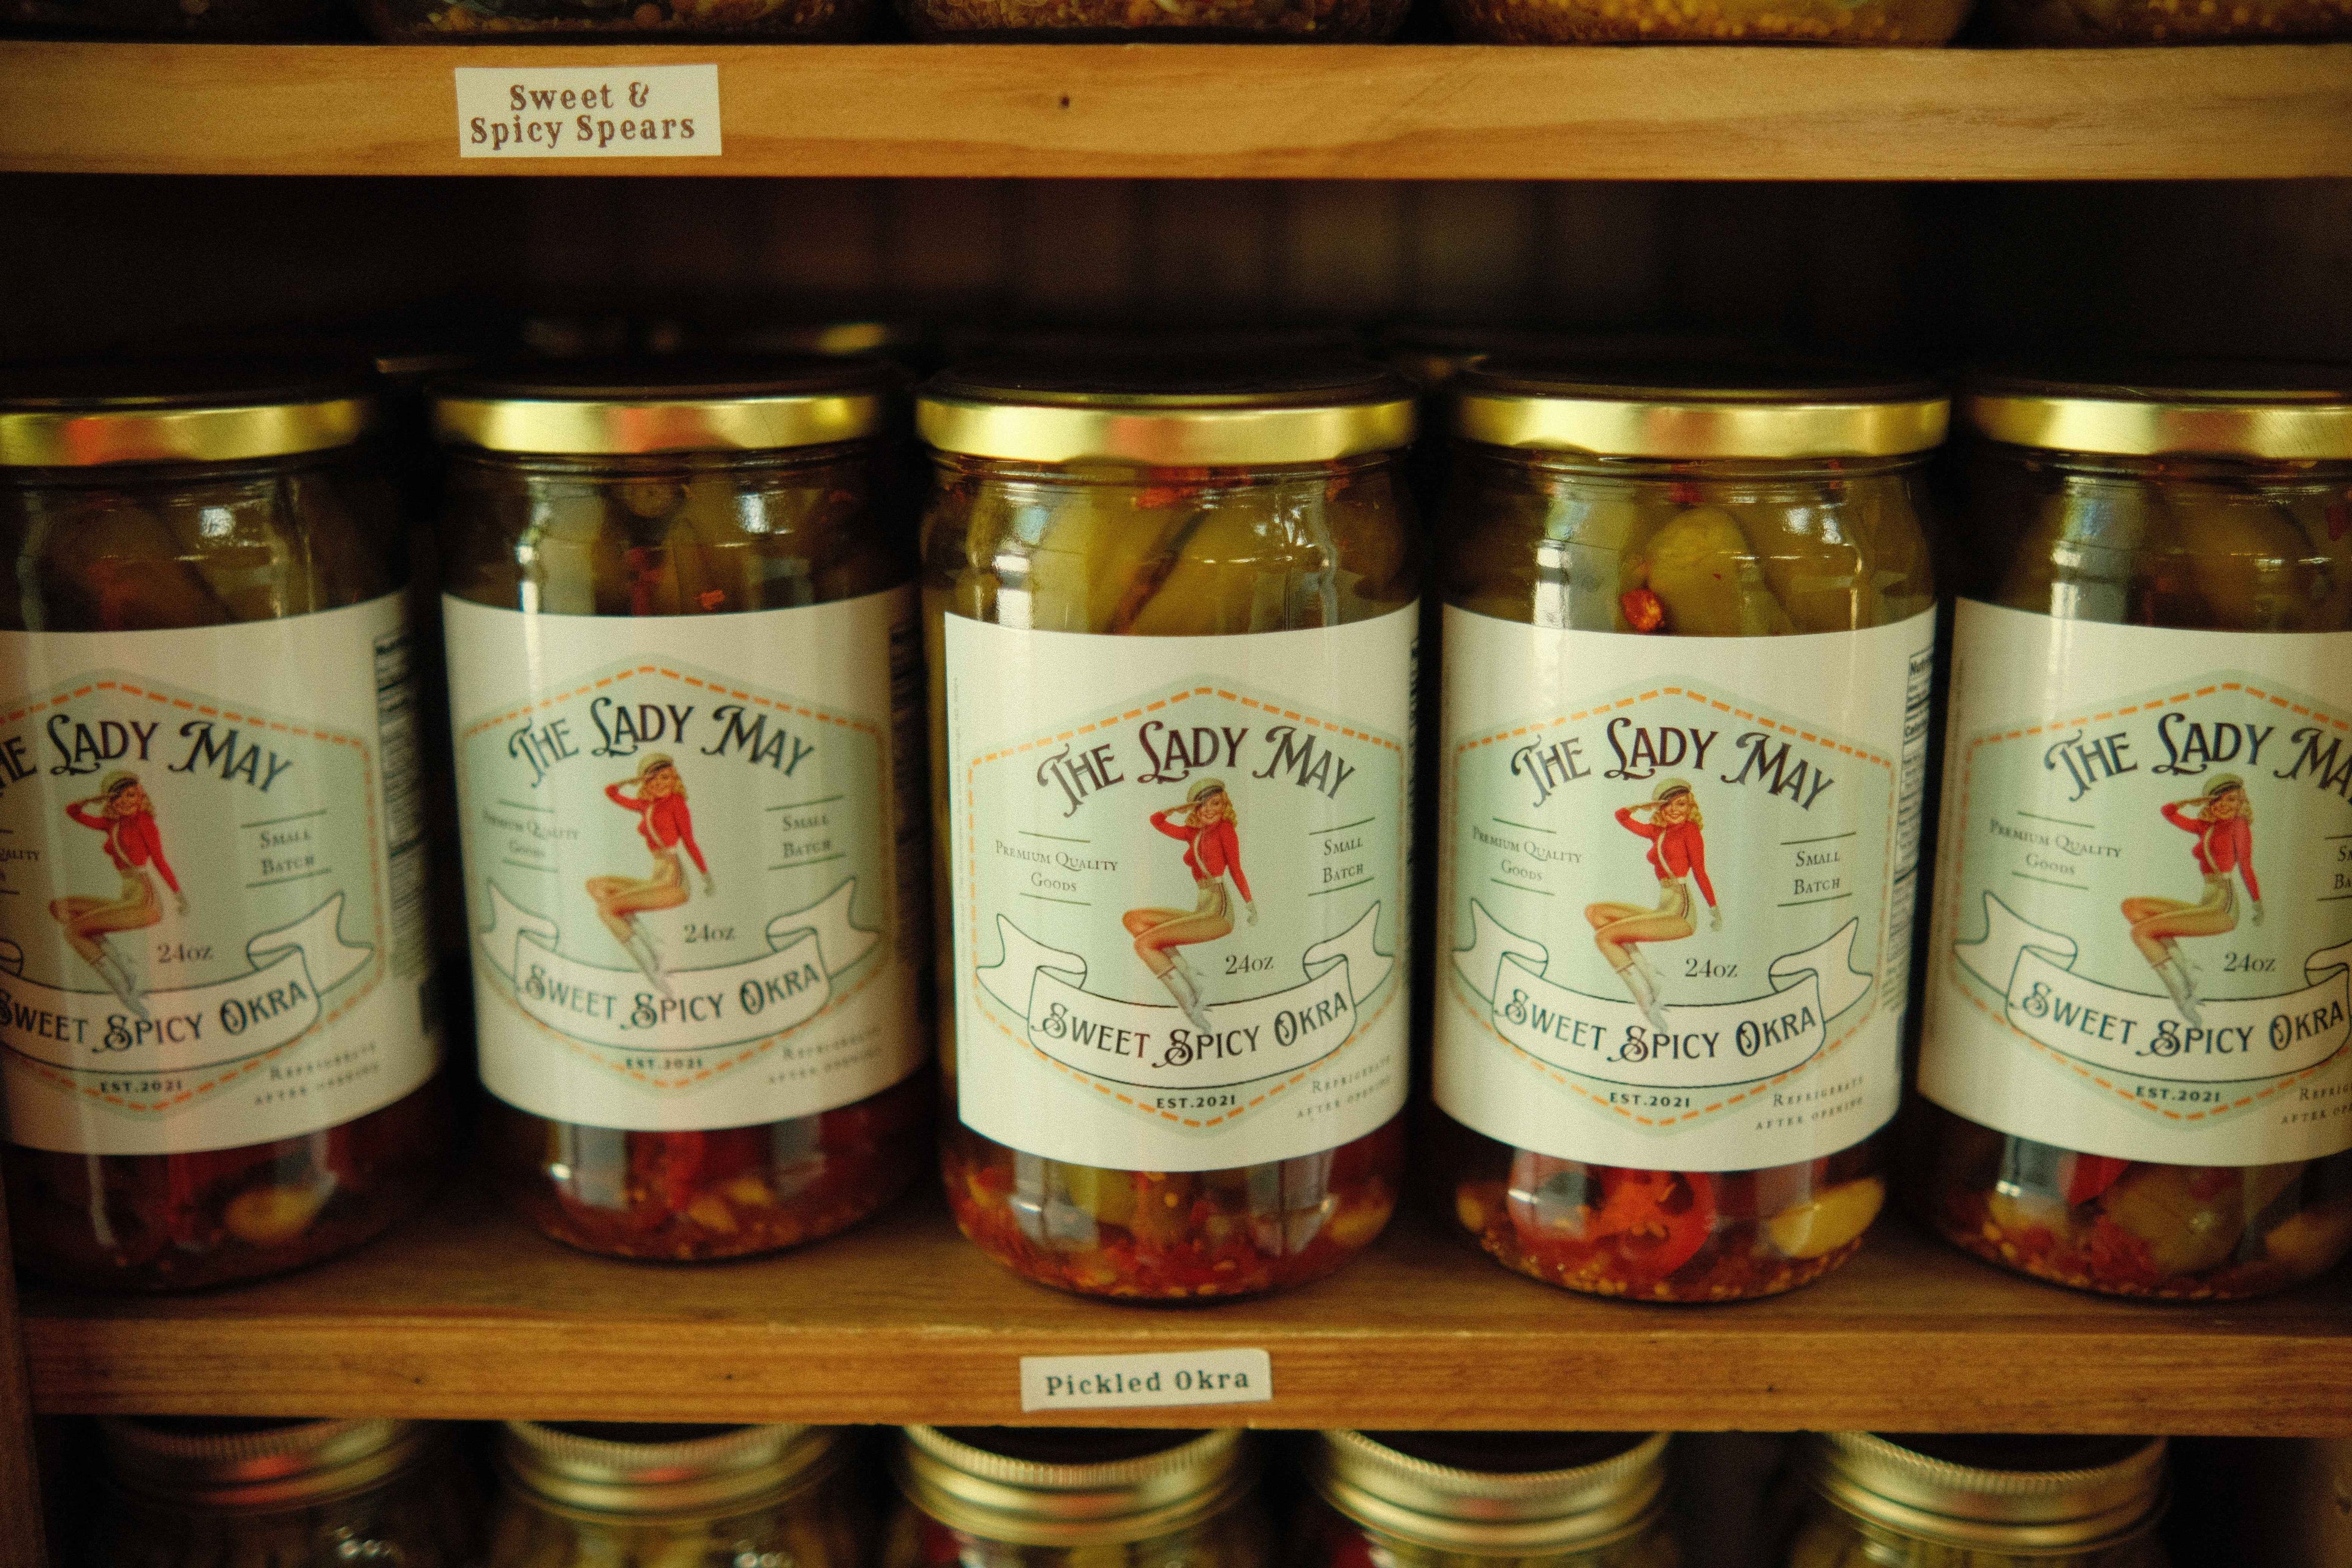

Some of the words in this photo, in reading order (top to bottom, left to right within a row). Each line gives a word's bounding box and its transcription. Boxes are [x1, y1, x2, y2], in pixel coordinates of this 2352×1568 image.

[510, 83, 614, 111] Sweet
[628, 81, 650, 108] &
[470, 115, 562, 151] Spicy
[576, 114, 695, 148] Spears
[0, 735, 38, 790] HE
[47, 714, 159, 775] LADY
[168, 721, 293, 793] MAY
[508, 717, 579, 788] THE
[590, 696, 693, 757] LADY
[701, 704, 815, 778] MAY
[1511, 735, 1591, 807] THE
[1604, 717, 1717, 780] LADY
[1721, 731, 1834, 812] MAY
[2044, 728, 2138, 802] THE
[2151, 712, 2274, 775] LADY
[2273, 727, 2352, 804] MA
[1037, 743, 1125, 818] THE
[1137, 720, 1249, 785] LADY
[1253, 725, 1357, 800] MAY
[157, 942, 213, 964] 24oz
[684, 922, 734, 945] 24oz
[1225, 954, 1275, 976] 24oz
[1684, 956, 1738, 979] 24oz
[2224, 951, 2277, 974] 24oz
[0, 989, 89, 1044] SWEET
[92, 1014, 203, 1054] SPICY
[219, 979, 307, 1035] OKRA
[516, 963, 616, 1019] SWEET
[620, 986, 725, 1030] SPICY
[740, 963, 821, 1014] OKRA
[2010, 980, 2137, 1047] SWEET
[2136, 1019, 2253, 1058] SPICY
[2268, 999, 2344, 1052] OKRA
[1030, 1001, 1152, 1058] SWEET
[1152, 1025, 1260, 1068] SPICY
[1274, 992, 1349, 1047] OKRA
[1493, 987, 1607, 1050] SWEET
[1607, 1025, 1720, 1063] SPICY
[1735, 1005, 1817, 1058] OKRA
[1157, 1095, 1236, 1109] EST.2021
[1609, 1093, 1691, 1109] EST.2021
[1046, 1371, 1161, 1396] Pickled
[1175, 1370, 1249, 1391] Okra
